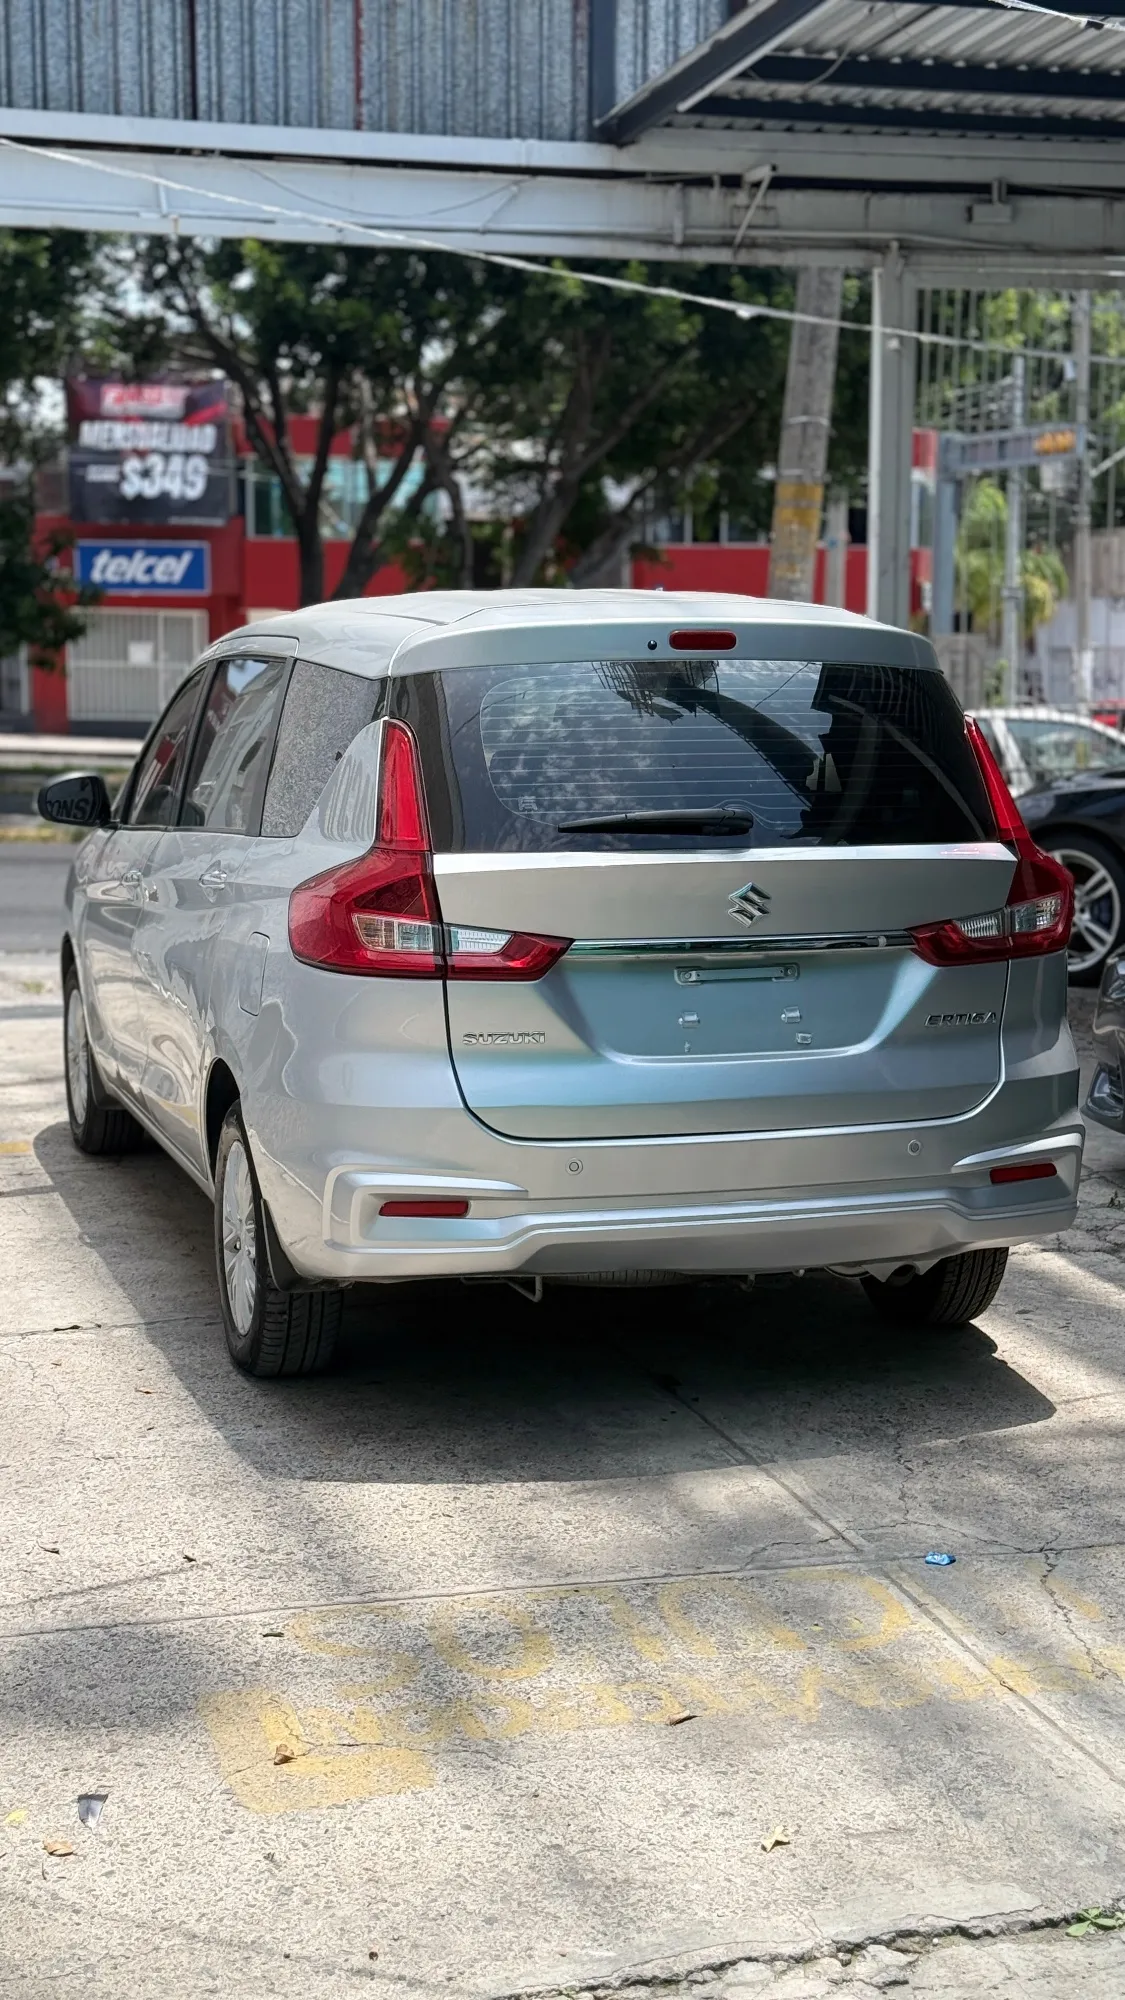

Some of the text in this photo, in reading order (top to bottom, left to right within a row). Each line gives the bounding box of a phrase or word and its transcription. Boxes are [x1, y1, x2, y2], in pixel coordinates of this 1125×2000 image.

[120, 454, 208, 499] $349
[90, 549, 193, 584] telcel
[924, 1011, 997, 1027] ERTIGA
[463, 1031, 546, 1045] SUZUKI
